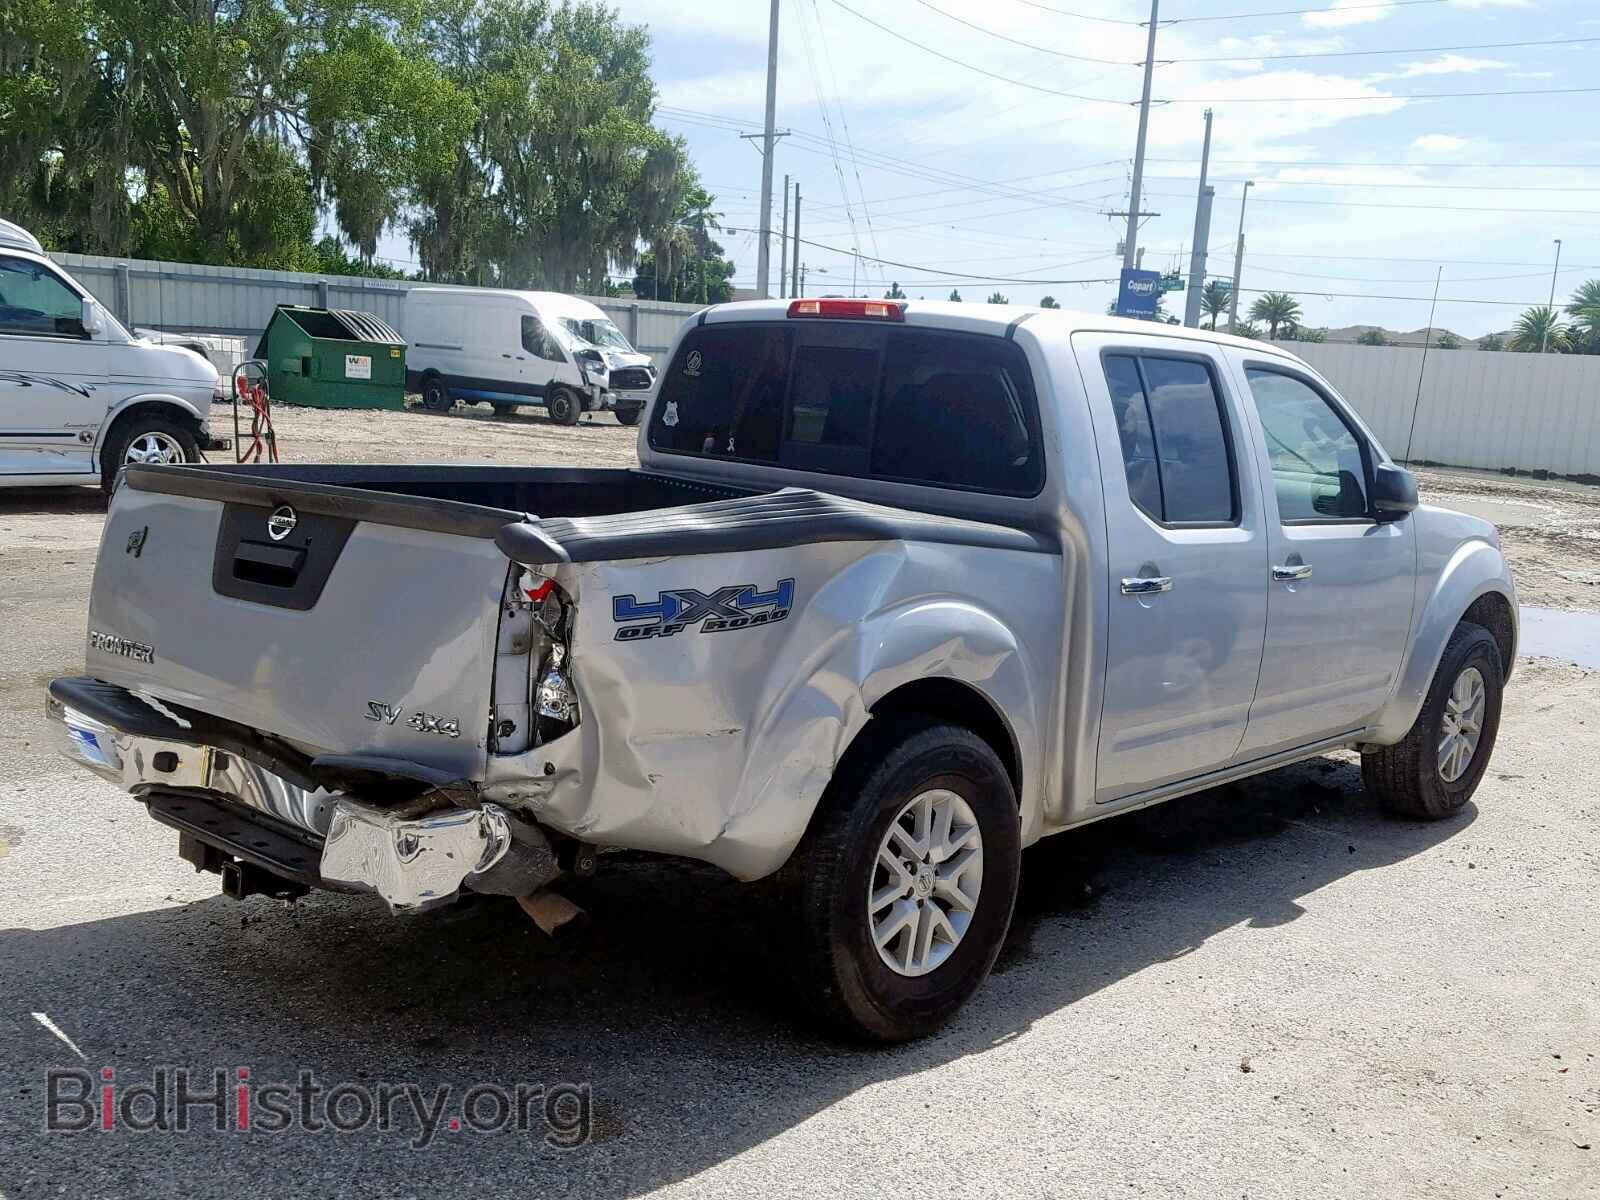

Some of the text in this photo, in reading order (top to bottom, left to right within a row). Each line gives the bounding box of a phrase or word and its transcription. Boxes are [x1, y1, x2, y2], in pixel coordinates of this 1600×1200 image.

[1127, 279, 1153, 293] Copart
[613, 608, 791, 642] OFF ROAD
[90, 631, 155, 665] FRONTIER
[364, 699, 403, 726] SV
